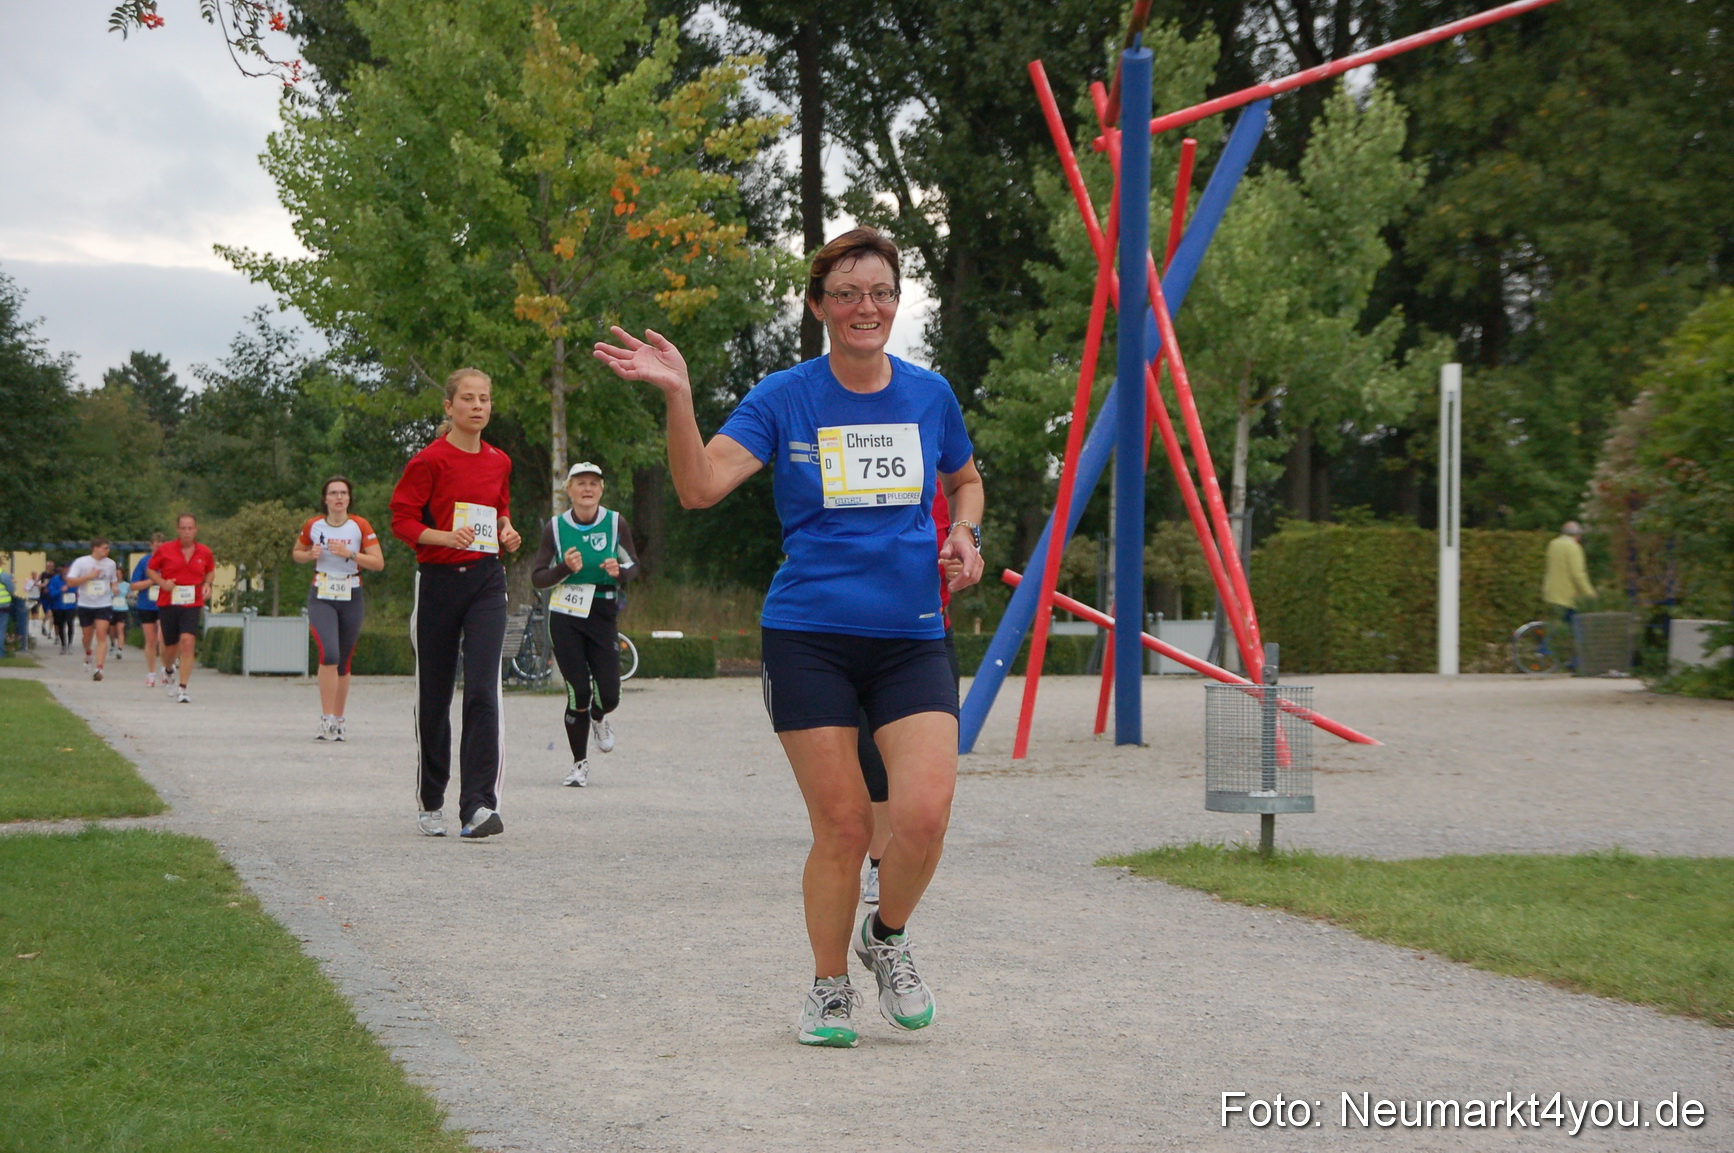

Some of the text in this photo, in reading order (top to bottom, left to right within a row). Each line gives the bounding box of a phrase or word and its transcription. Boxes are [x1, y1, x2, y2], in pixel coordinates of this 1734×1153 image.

[847, 433, 893, 448] Christa
[825, 458, 832, 470] D
[858, 456, 906, 479] 756
[474, 523, 492, 537] 962
[330, 584, 345, 592] 436
[565, 593, 584, 606] 461
